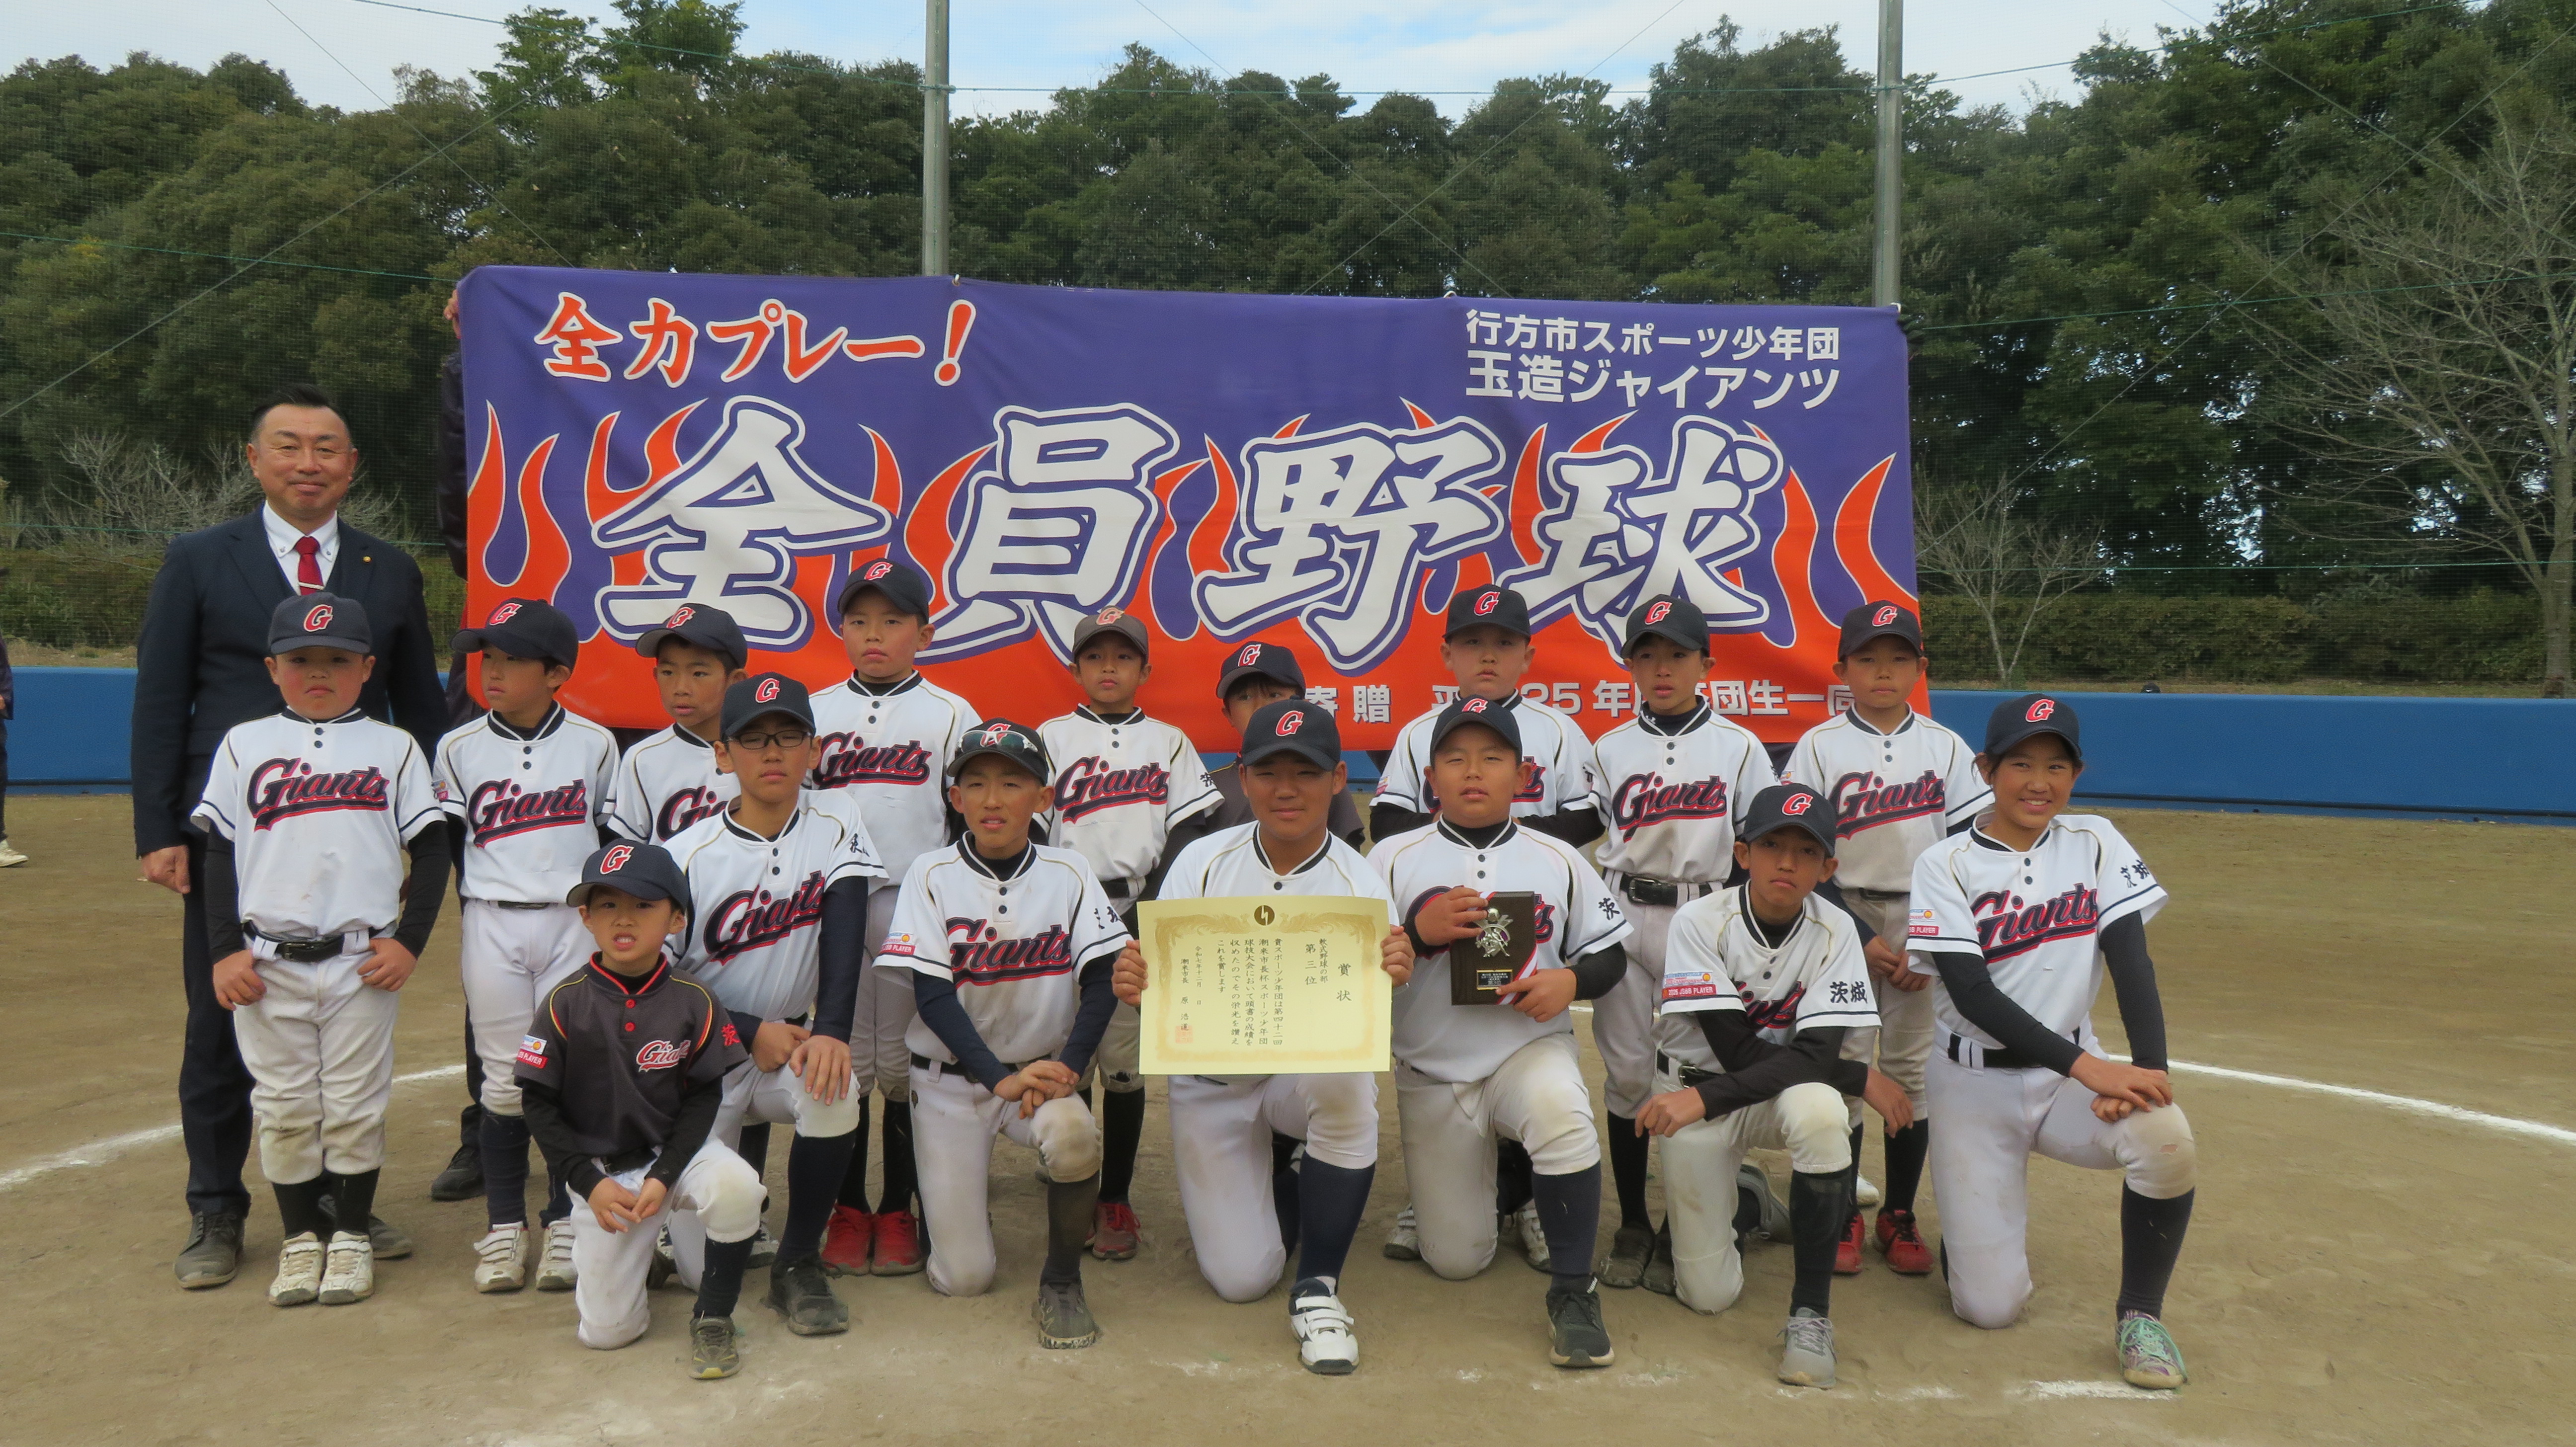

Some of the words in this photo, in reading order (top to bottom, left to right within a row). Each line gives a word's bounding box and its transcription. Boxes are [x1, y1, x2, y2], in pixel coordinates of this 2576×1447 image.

[1466, 309, 1840, 361] 行方市スポーツ少年団
[1466, 349, 1840, 409] 玉造ジャイアンツ
[591, 395, 1789, 671] 全員野球
[865, 561, 893, 580] G
[303, 604, 333, 632] G
[489, 603, 522, 626] G
[1096, 607, 1125, 626] G
[1473, 591, 1501, 616] G
[1645, 601, 1672, 625] G
[1872, 605, 1898, 627] G
[666, 607, 696, 630] G
[1237, 644, 1262, 667] G
[755, 677, 780, 704] G
[1461, 698, 1488, 714] G
[2025, 699, 2054, 723] G
[1275, 710, 1304, 737] G
[812, 730, 933, 790] Giants
[247, 757, 391, 832] Giants
[1053, 755, 1170, 824] Giants
[466, 777, 588, 849] Giants
[1611, 771, 1728, 844] Giants
[1781, 793, 1814, 816] G
[1829, 769, 1945, 841] Giants
[600, 845, 634, 875] G
[1598, 897, 1620, 920] 茨
[945, 916, 1072, 991] Giants
[1217, 940, 1226, 993] これを賞します
[1304, 944, 1317, 985] 第三位
[1319, 938, 1328, 983] 軟式野球の部
[1180, 958, 1190, 984] 潮来市長
[1336, 963, 1352, 1002] 賞状
[1244, 938, 1255, 1046] 球技大会において頭書の成績を
[1258, 938, 1269, 1045] 潮来市長杯スポーツ少年団
[1273, 938, 1284, 1045] 貴スポーツ少年団は第四十二回
[1829, 980, 1868, 1004] 茨城
[523, 1052, 543, 1065] PLAYER
